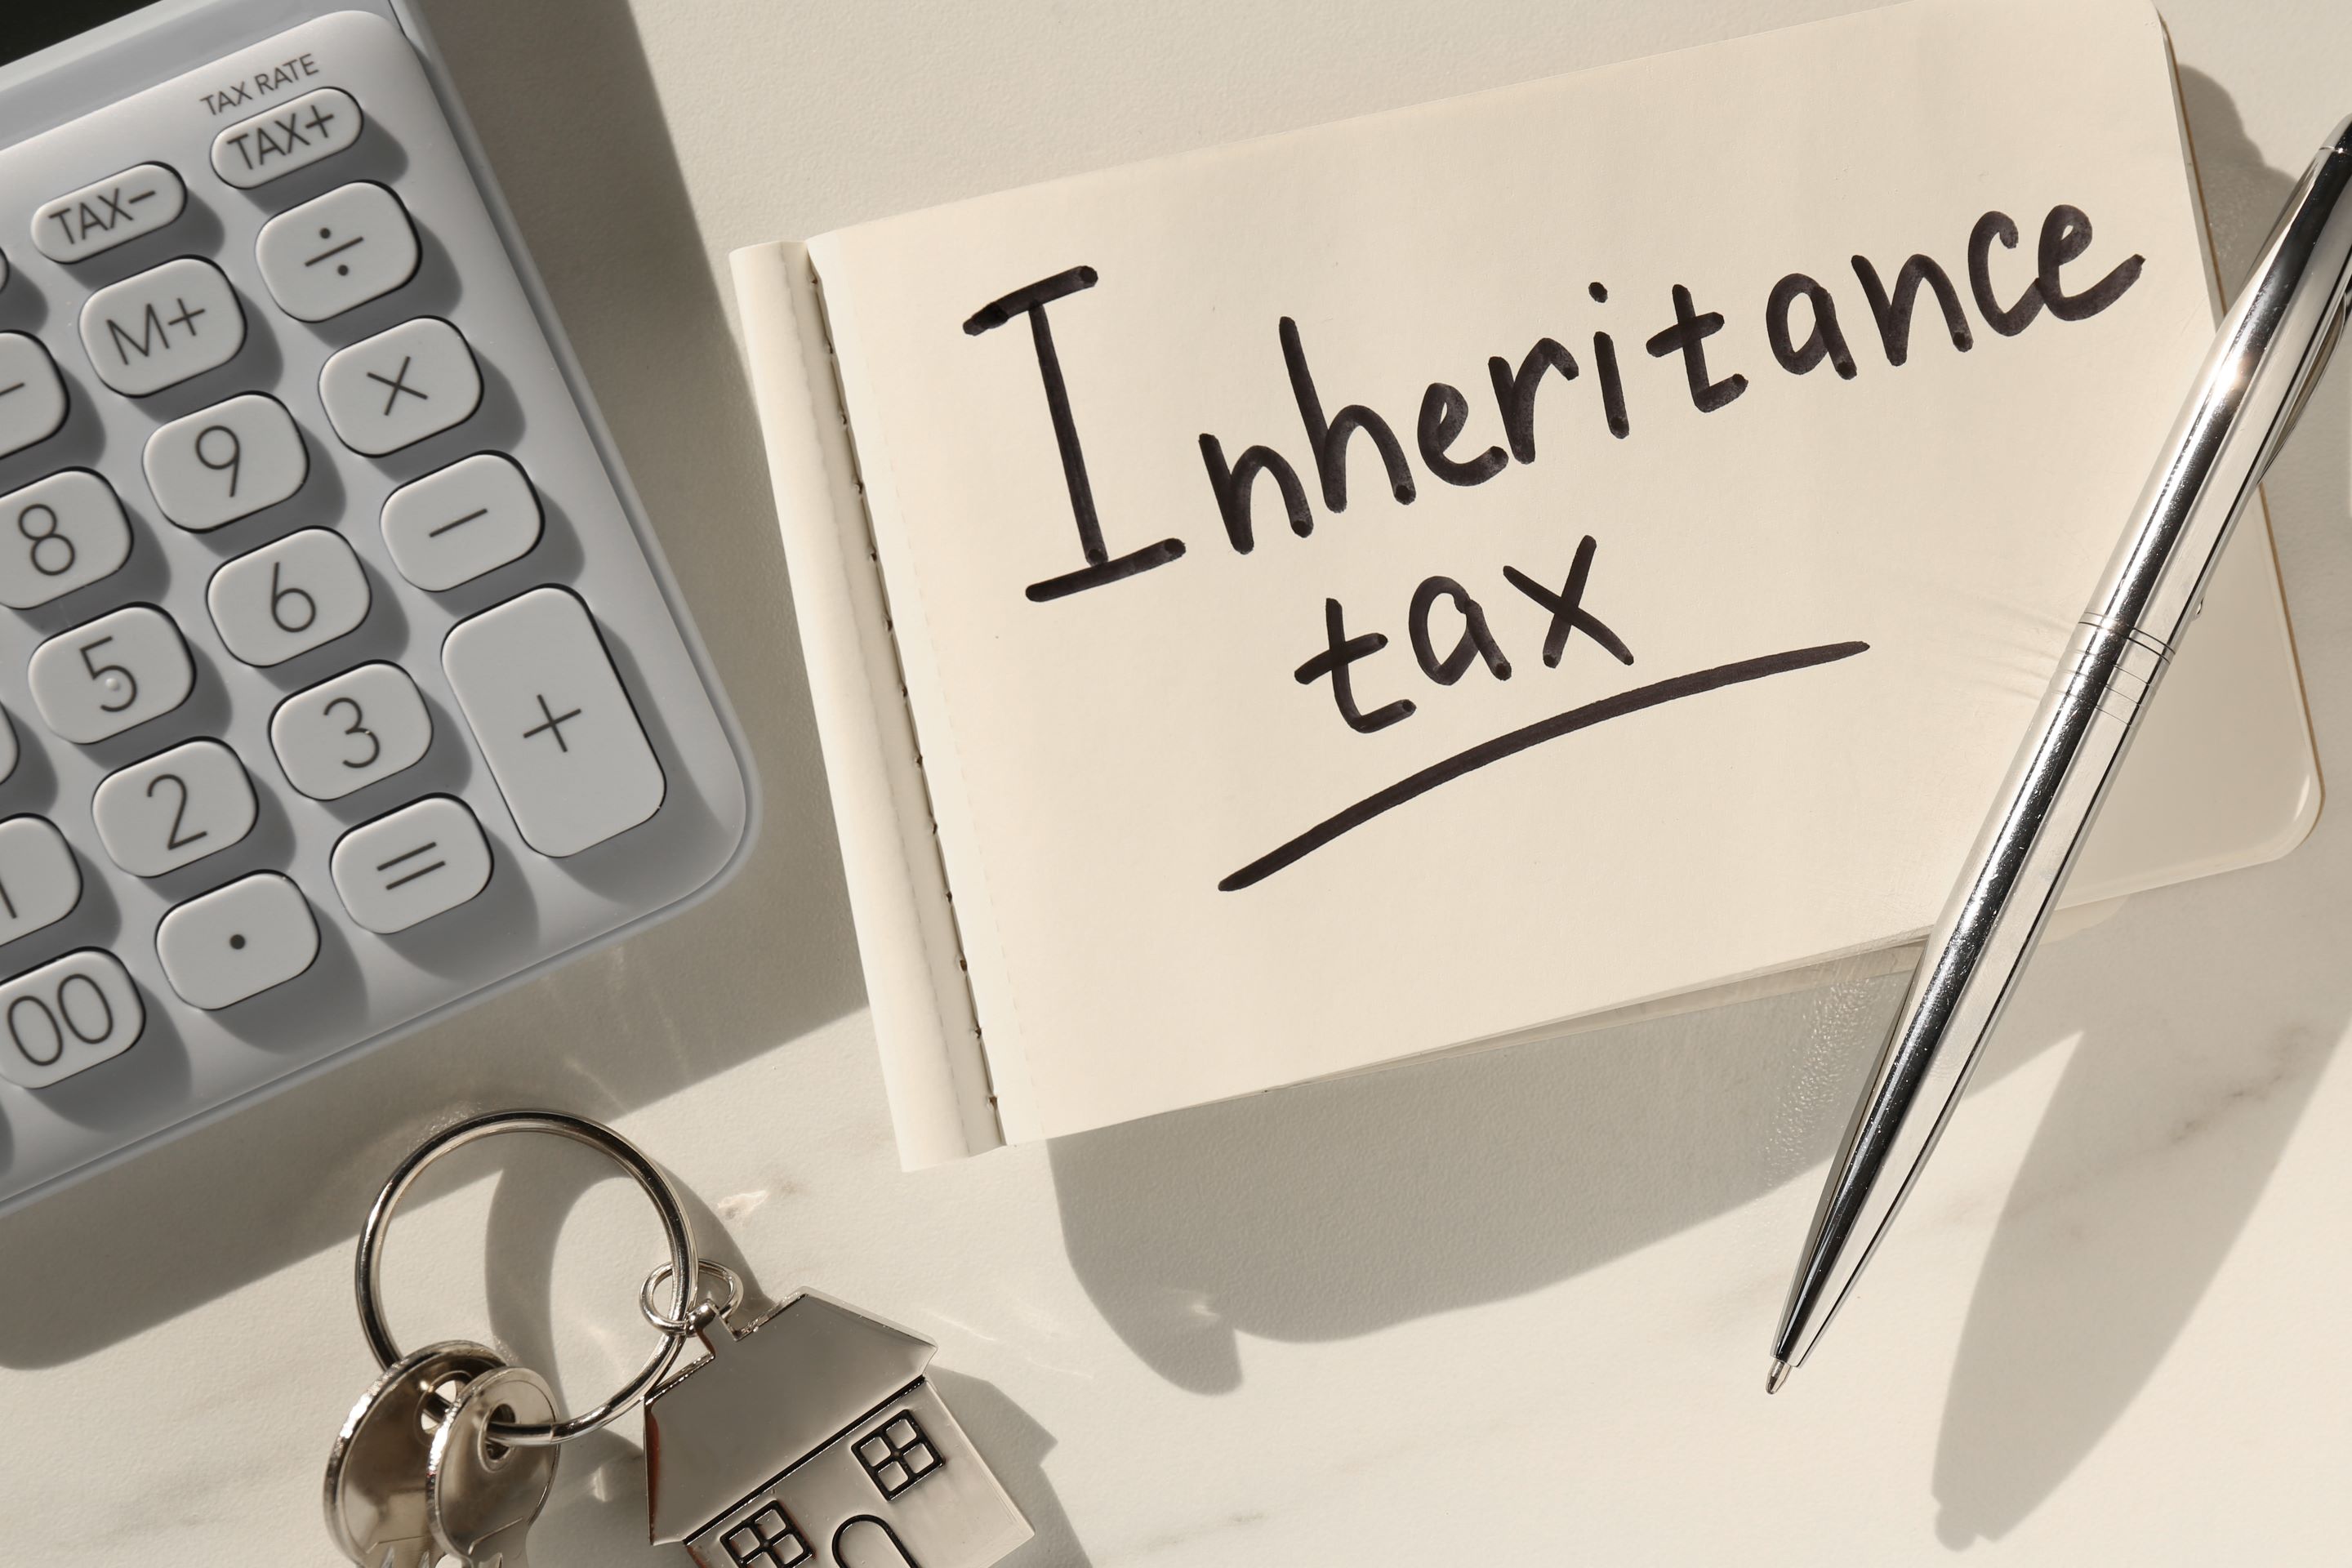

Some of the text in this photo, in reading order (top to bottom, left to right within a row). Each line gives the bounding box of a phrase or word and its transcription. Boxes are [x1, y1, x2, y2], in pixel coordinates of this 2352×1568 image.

[200, 52, 320, 117] TAX RATE
[226, 104, 335, 170] TAX+
[48, 187, 157, 245] TAX-
[106, 297, 206, 366] M+
[963, 204, 2147, 603] Inheritance
[195, 425, 241, 497] 9
[17, 503, 76, 577] 8
[270, 561, 317, 634] 6
[1294, 534, 1635, 734] tax
[78, 635, 138, 713] 5
[323, 697, 381, 769] 3
[146, 773, 207, 851] 2
[7, 973, 114, 1067] 00
